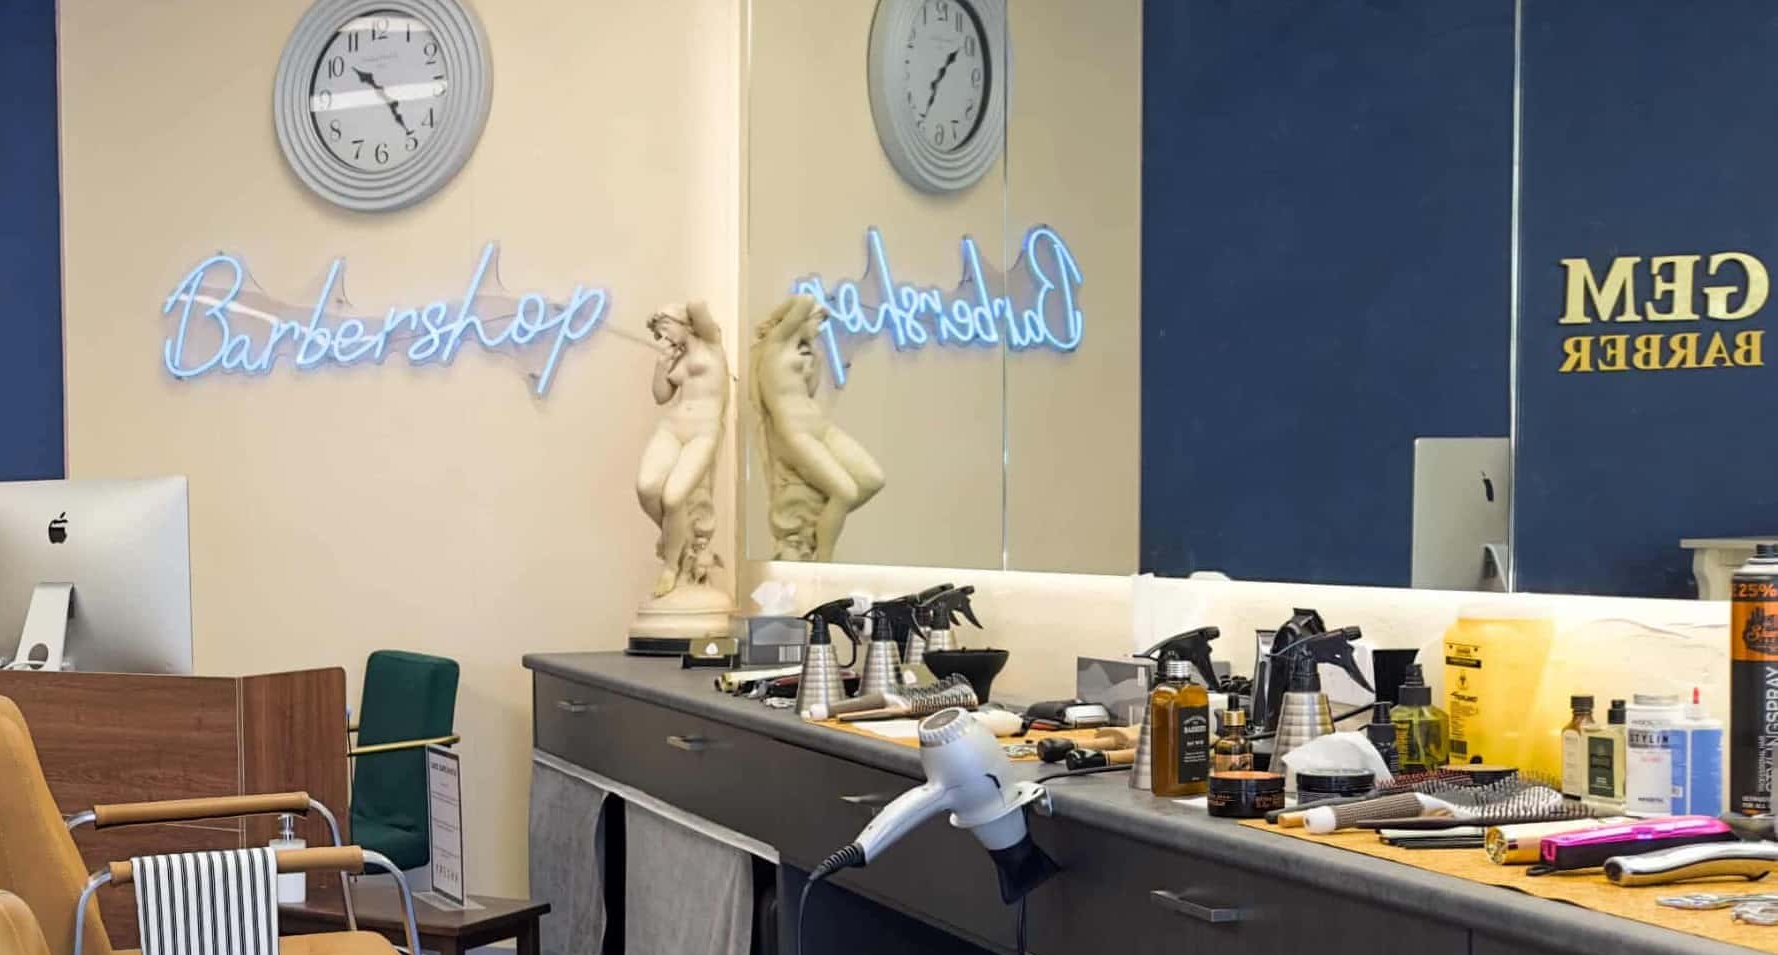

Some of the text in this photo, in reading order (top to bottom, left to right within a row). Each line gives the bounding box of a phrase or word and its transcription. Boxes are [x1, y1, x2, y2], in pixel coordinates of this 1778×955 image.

[328, 55, 344, 79] 10
[330, 118, 342, 142] 8
[352, 139, 365, 160] 7
[374, 143, 389, 165] 6
[162, 241, 610, 395] Barbershop
